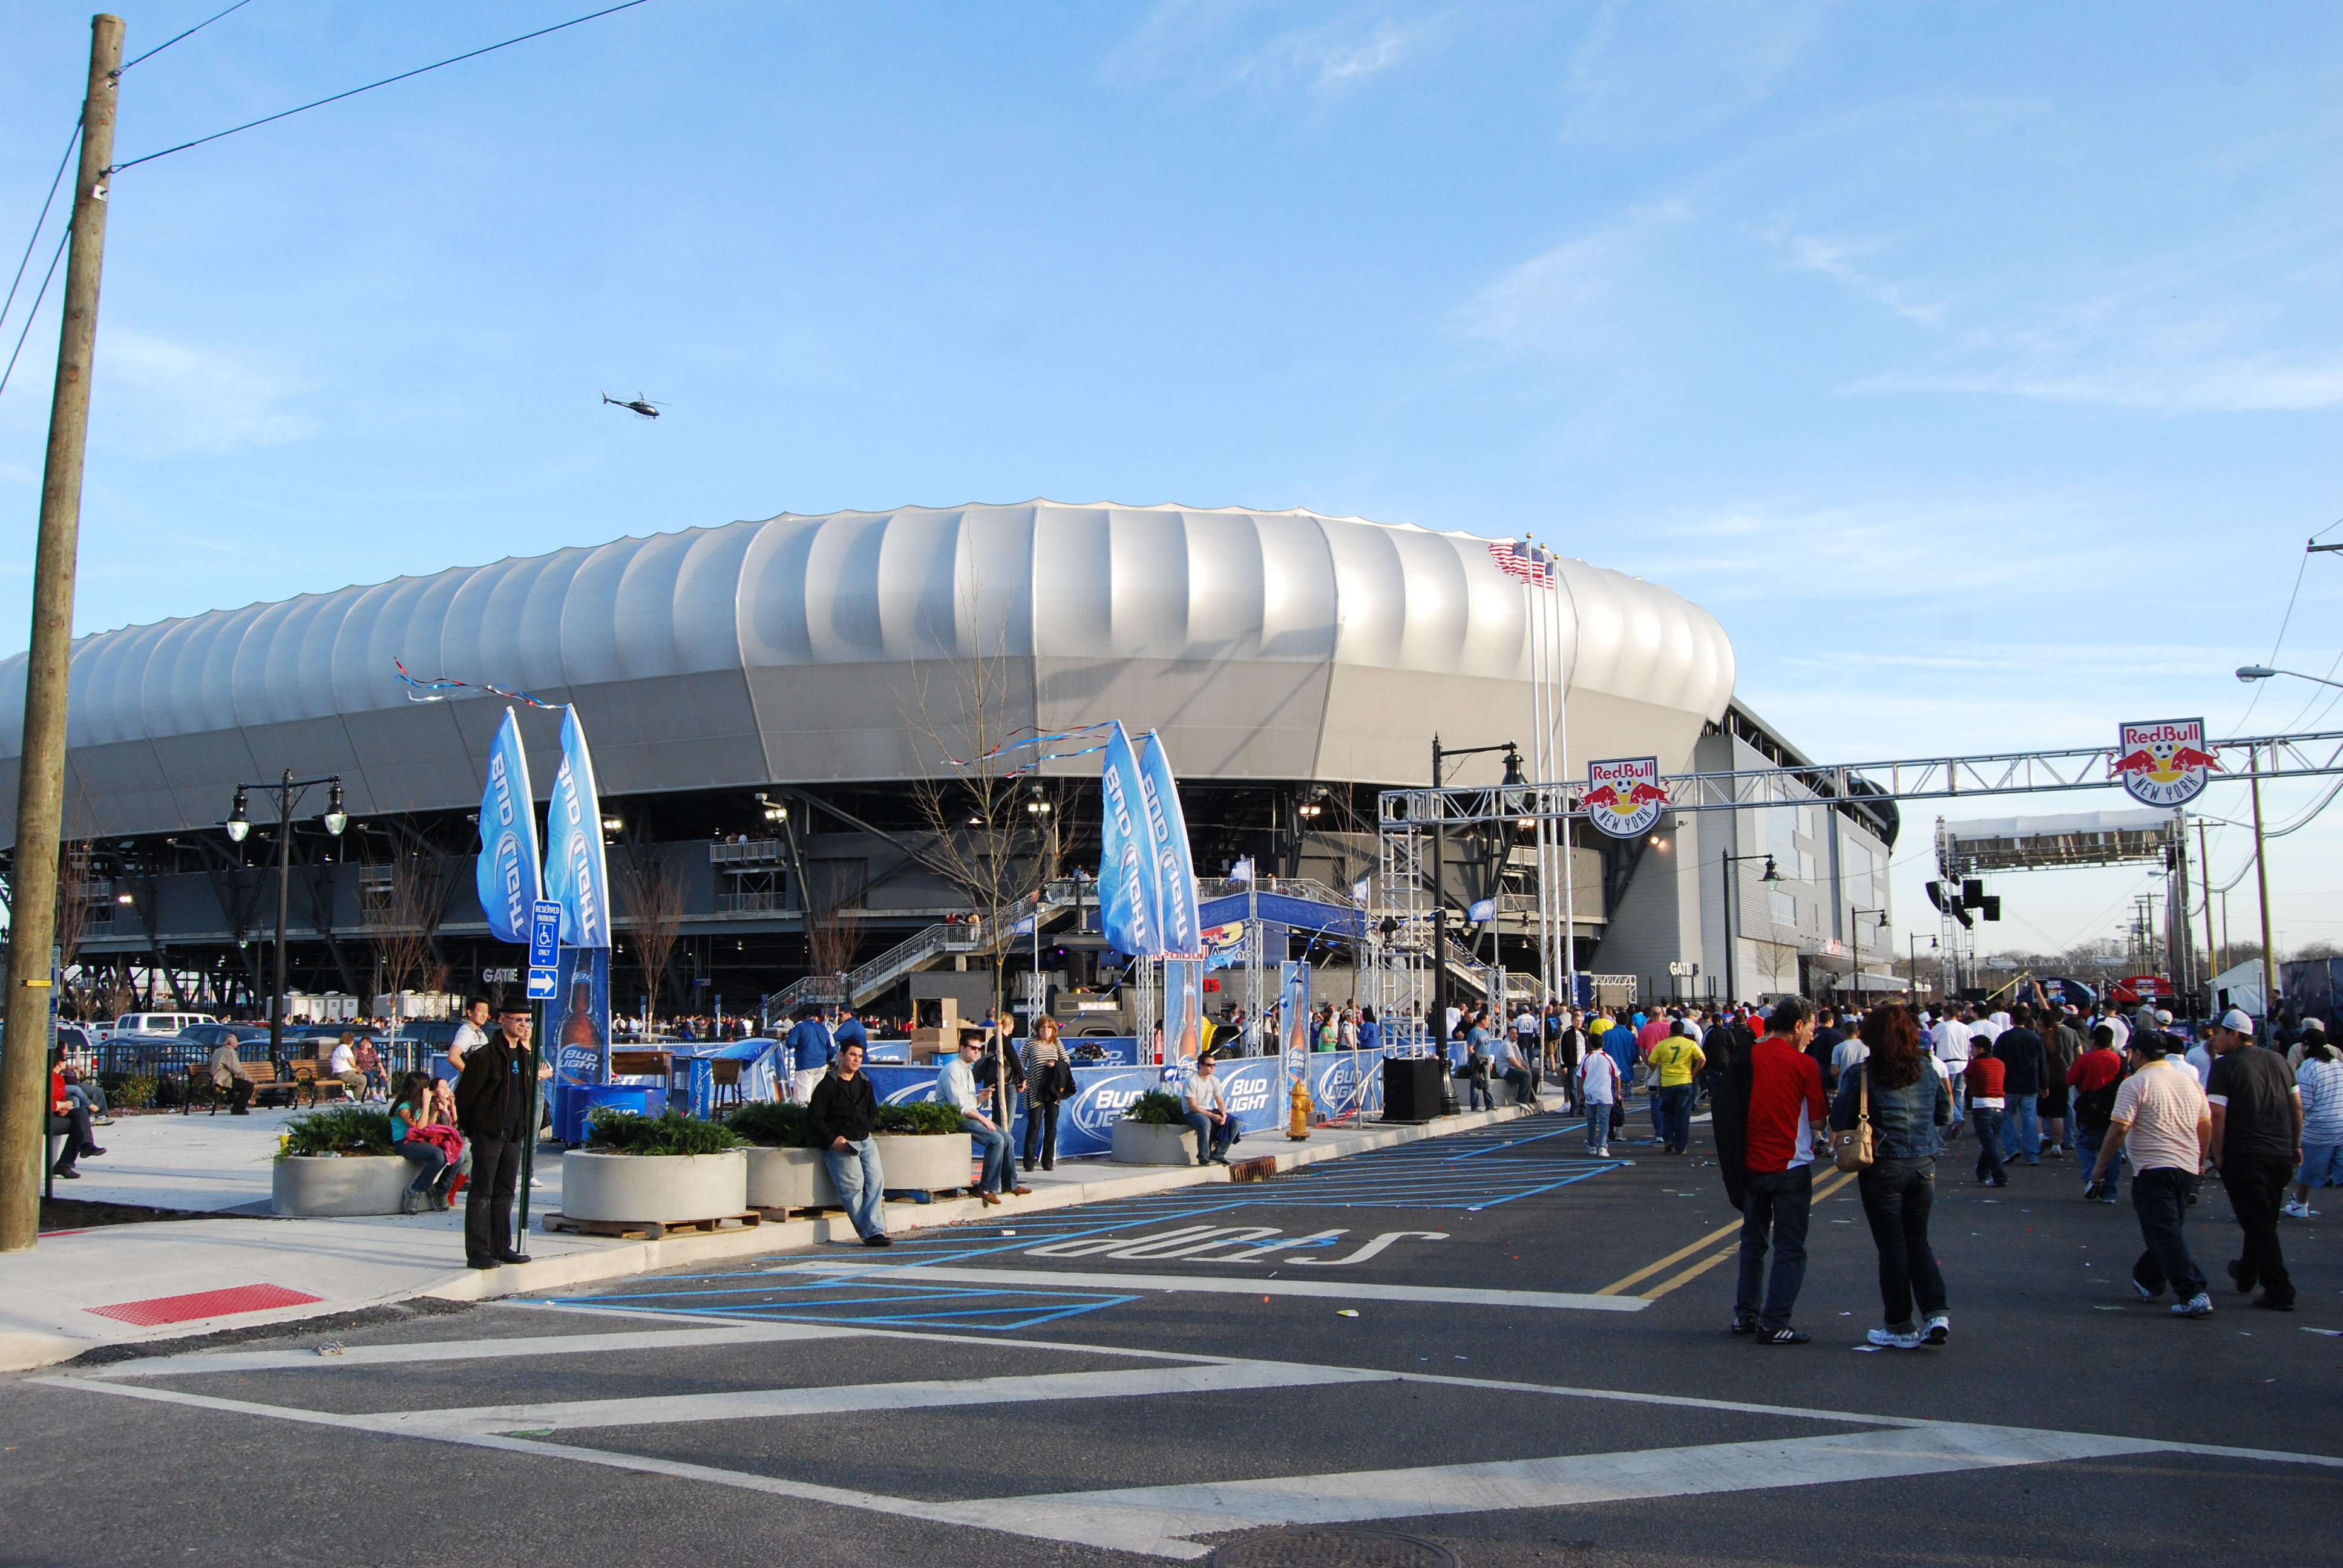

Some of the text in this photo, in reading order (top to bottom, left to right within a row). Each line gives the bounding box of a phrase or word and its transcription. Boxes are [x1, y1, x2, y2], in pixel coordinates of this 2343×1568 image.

[2126, 724, 2198, 745] Red Bull
[1593, 762, 1653, 780] Red Bull
[2132, 774, 2199, 801] NEW YORK
[1598, 807, 1653, 831] NEW YORK
[536, 905, 560, 914] RESERVED
[537, 914, 557, 923] PARKING
[483, 969, 518, 982] GATE
[1670, 961, 1690, 976] GATE
[564, 1049, 598, 1062] BUD
[1670, 1046, 1680, 1064] 7
[559, 1059, 599, 1071] LIGHT
[1231, 1079, 1267, 1096] BUD
[1225, 1094, 1269, 1113] LIGHT
